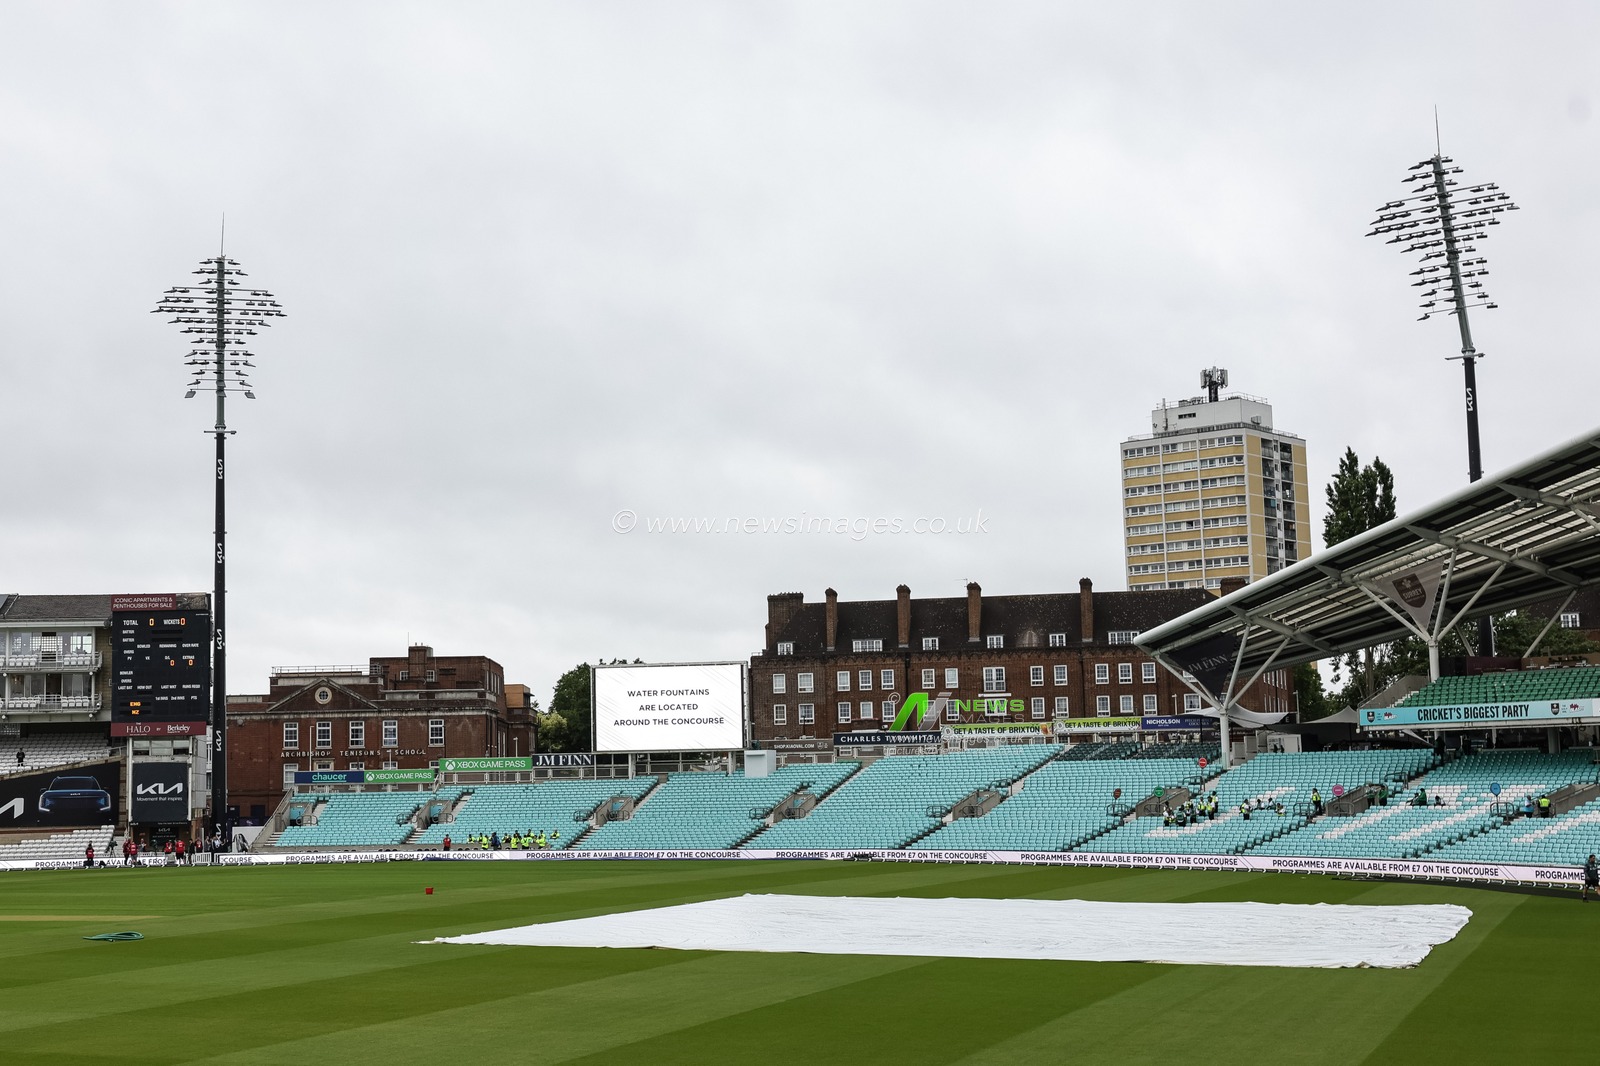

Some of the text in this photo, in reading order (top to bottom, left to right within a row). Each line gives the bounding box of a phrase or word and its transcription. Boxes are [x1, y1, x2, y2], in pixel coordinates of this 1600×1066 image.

[1418, 705, 1529, 721] CRICKET'S BIGGEST PARTY
[536, 754, 592, 766] JM FINN
[312, 772, 347, 780] chaucer
[1193, 857, 1238, 866] CONCOURSE
[1272, 860, 1324, 869] PROGRAMMES
[1344, 862, 1387, 871] AVAILABLE
[1389, 864, 1410, 872] FROM
[1436, 866, 1450, 874] THE
[1452, 866, 1498, 876] CONCOURSE
[1535, 870, 1585, 880] PROGRAMME
